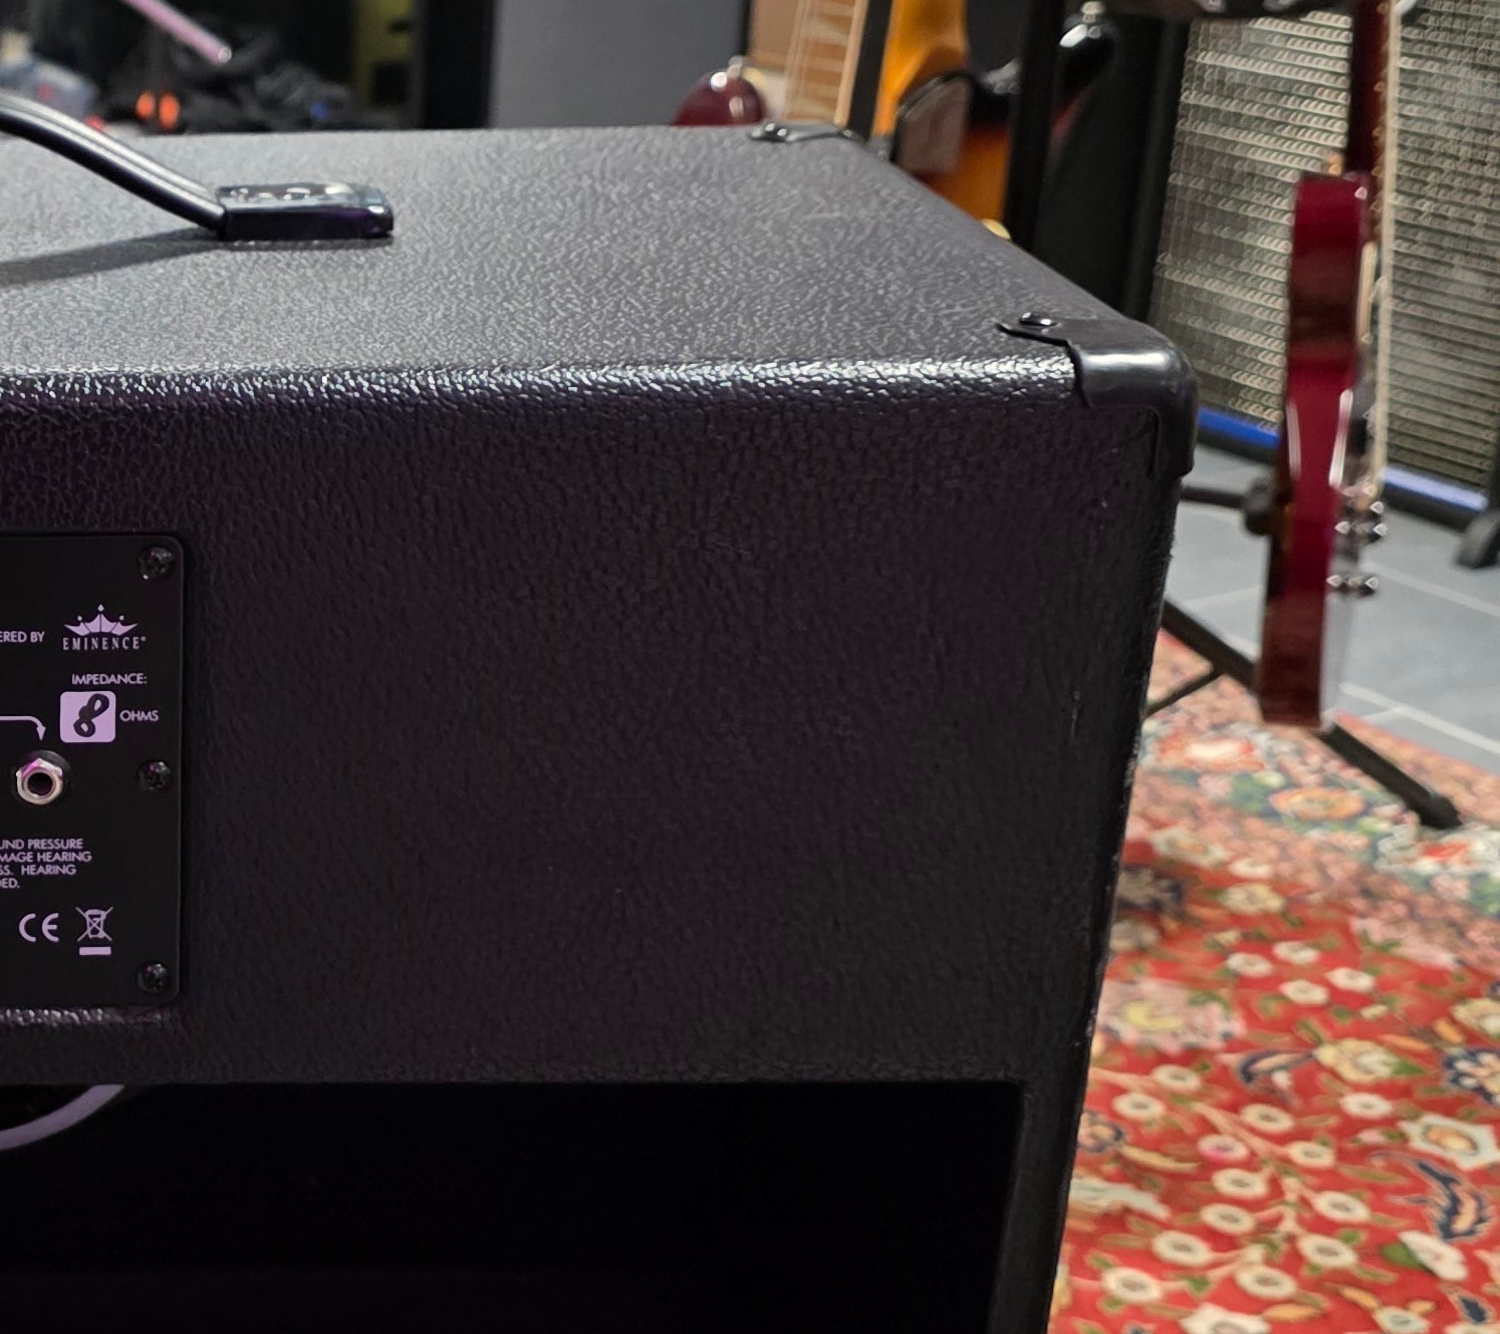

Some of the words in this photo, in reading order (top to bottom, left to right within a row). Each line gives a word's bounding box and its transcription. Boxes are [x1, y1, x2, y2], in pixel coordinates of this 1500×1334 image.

[29, 630, 45, 643] BY
[71, 672, 148, 685] IMPEDANCE:
[73, 693, 110, 738] 8
[119, 710, 160, 722] OHMS
[27, 838, 84, 850] PRESSURE
[37, 850, 93, 862] HEARING
[21, 864, 77, 876] HEARING
